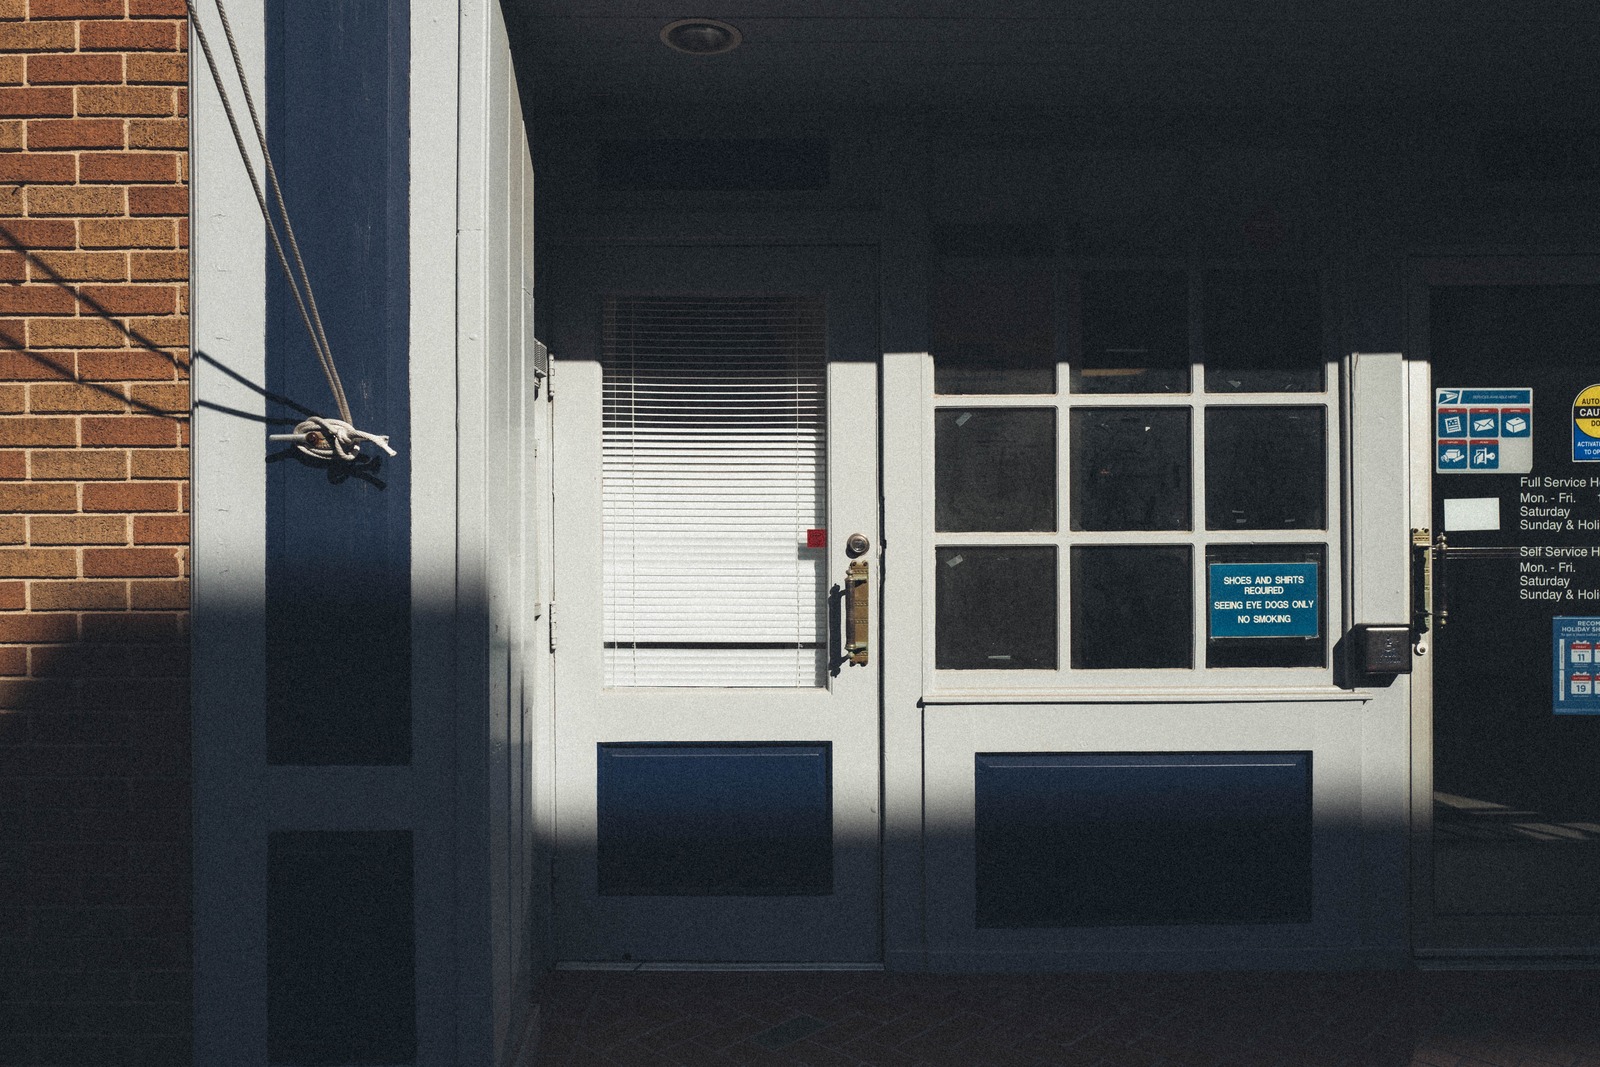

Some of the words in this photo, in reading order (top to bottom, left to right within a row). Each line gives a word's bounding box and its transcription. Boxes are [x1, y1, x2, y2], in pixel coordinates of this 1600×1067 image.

[1580, 408, 1600, 416] CAU
[1520, 477, 1540, 488] Full
[1544, 477, 1586, 488] Service
[1590, 477, 1600, 488] H
[1520, 493, 1547, 503] Mon.
[1559, 493, 1576, 503] Fri.
[1520, 506, 1570, 519] Saturday
[1520, 520, 1562, 532] Sunday
[1566, 520, 1574, 530] &
[1520, 546, 1542, 557] Self
[1545, 546, 1588, 557] Service
[1520, 562, 1547, 572] Mon.
[1559, 562, 1576, 572] Fri.
[1224, 576, 1251, 585] SHOES
[1255, 576, 1272, 584] AND
[1275, 576, 1304, 584] SHIRTS
[1520, 576, 1570, 588] Saturday
[1244, 586, 1284, 595] REQUIRED
[1520, 589, 1562, 602] Sunday
[1566, 589, 1574, 600] &
[1214, 601, 1243, 609] SEEING
[1246, 601, 1262, 609] EYE
[1265, 600, 1289, 609] DOGS
[1292, 600, 1314, 608] ONLY
[1237, 615, 1250, 624] NO
[1253, 615, 1291, 623] SMOKING
